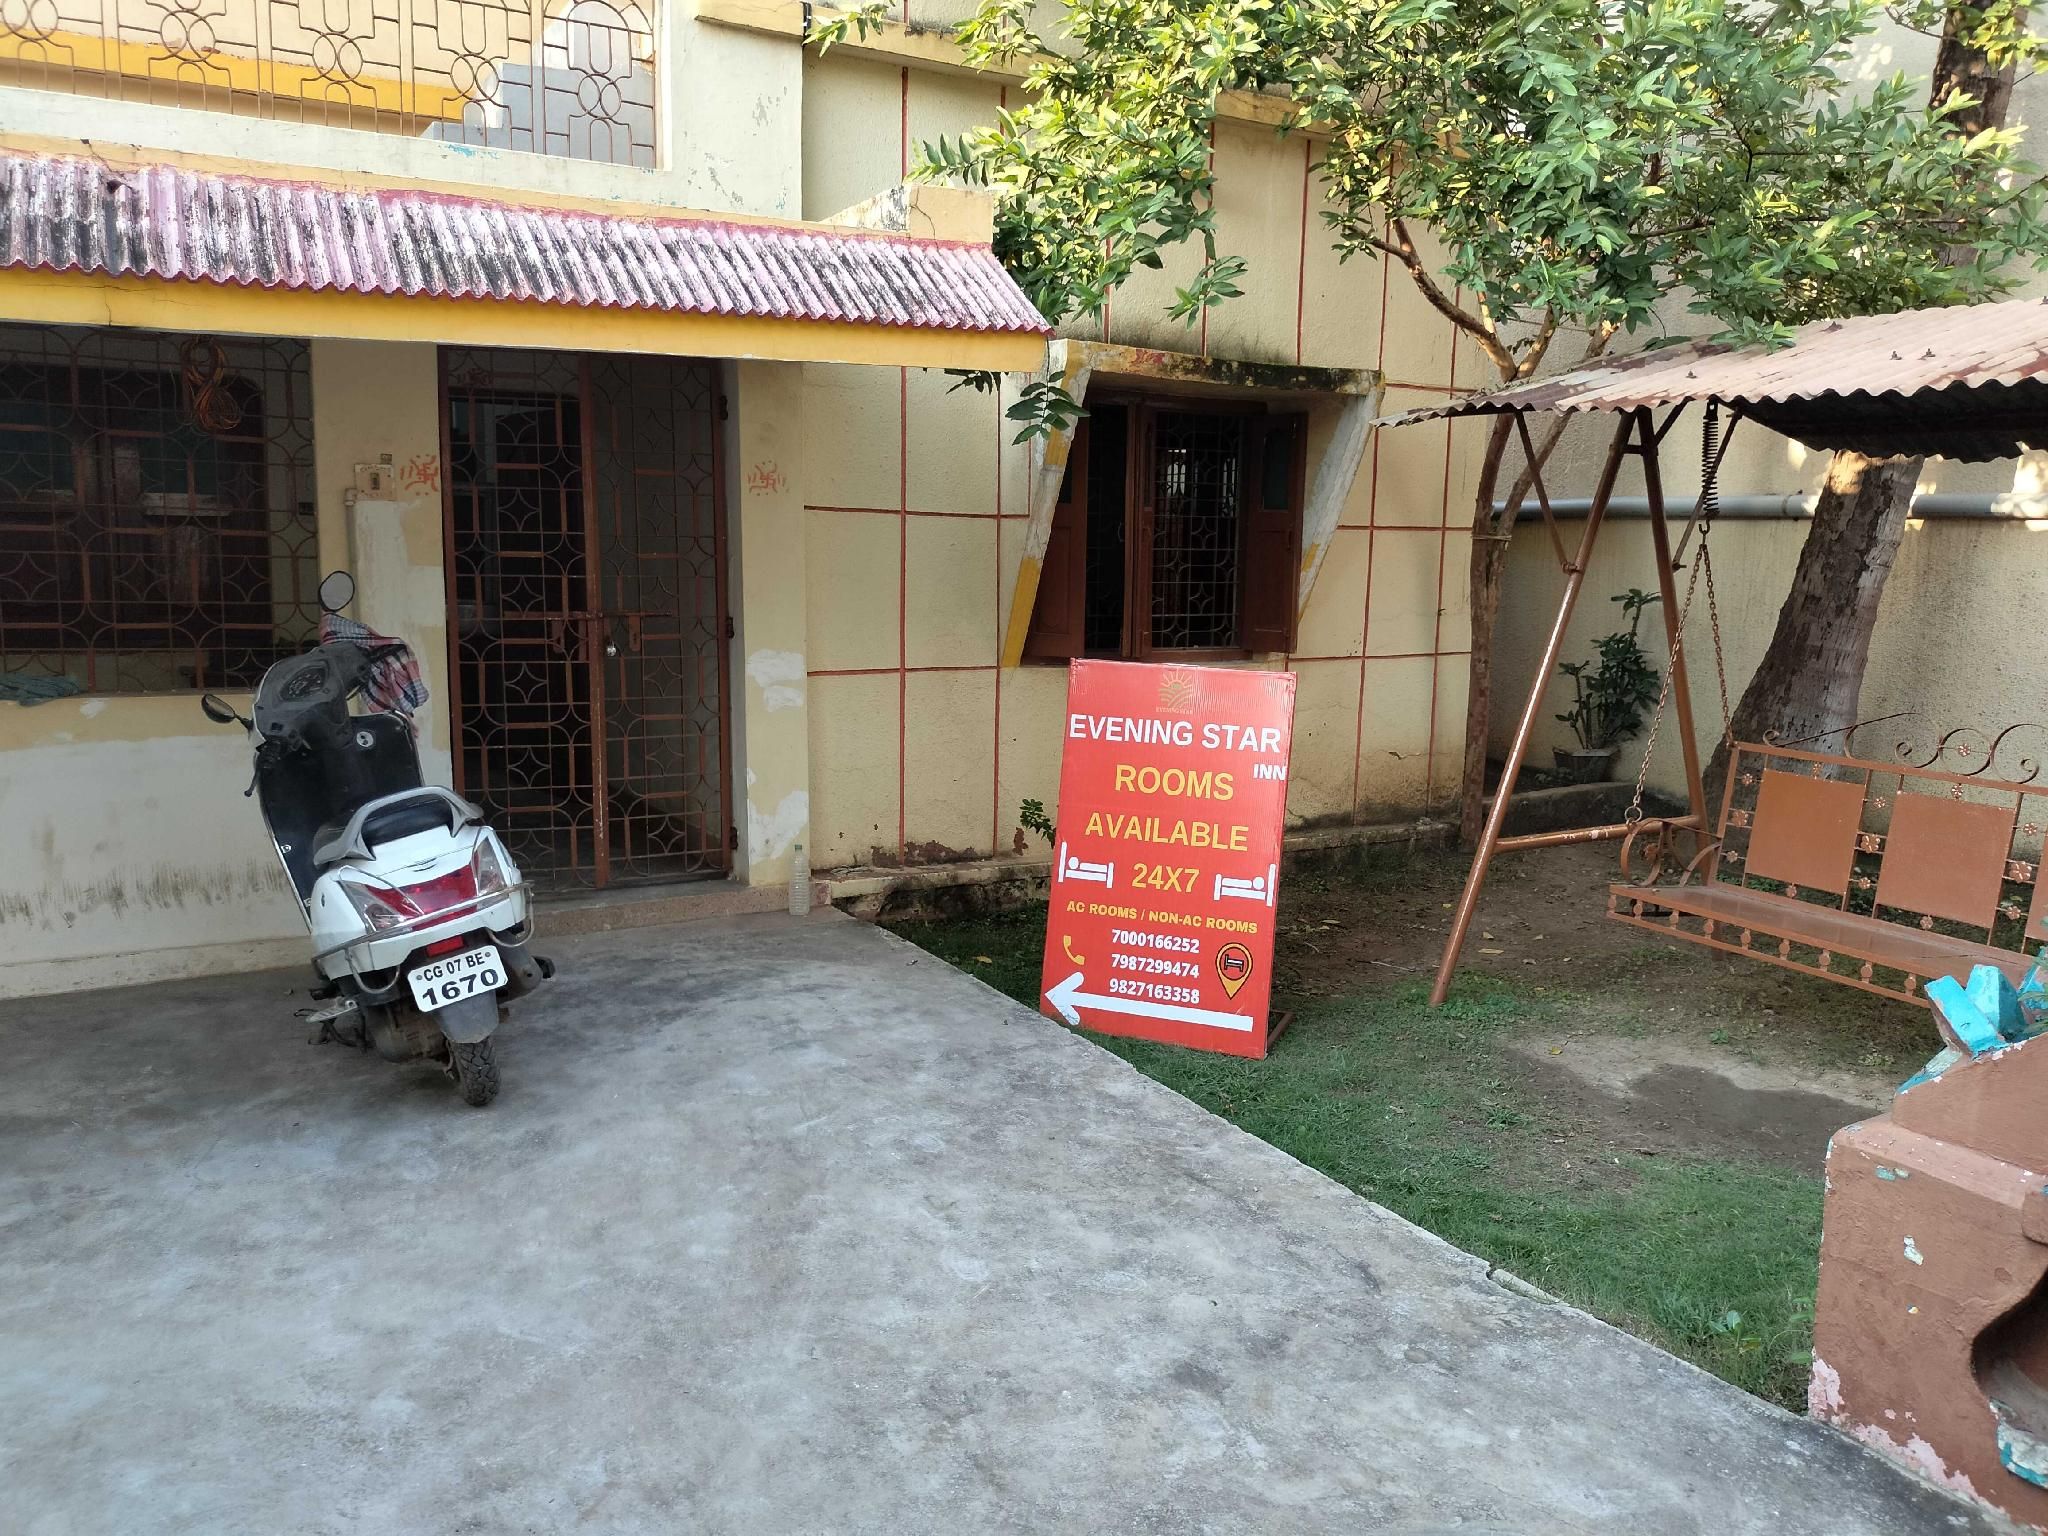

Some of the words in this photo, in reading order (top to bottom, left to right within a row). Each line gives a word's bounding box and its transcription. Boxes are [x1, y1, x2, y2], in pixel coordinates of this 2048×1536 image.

[1069, 713, 1193, 746] EVENING
[1201, 723, 1281, 753] STAR
[1115, 764, 1234, 801] ROOMS
[1253, 763, 1287, 781] INN
[1085, 812, 1249, 851] AVAILABLE
[1132, 863, 1200, 893] 24X7
[1066, 900, 1085, 913] AC
[1089, 903, 1137, 920] ROOMS
[1149, 911, 1202, 927] NON-AC
[1206, 917, 1258, 934] ROOMS
[1111, 929, 1200, 954] 7000166252
[423, 965, 443, 982] CG
[446, 958, 462, 975] 07
[465, 952, 485, 969] BE
[1111, 954, 1200, 978] 7987299474
[422, 968, 499, 1006] 1670
[1109, 978, 1200, 1004] 9827163358
